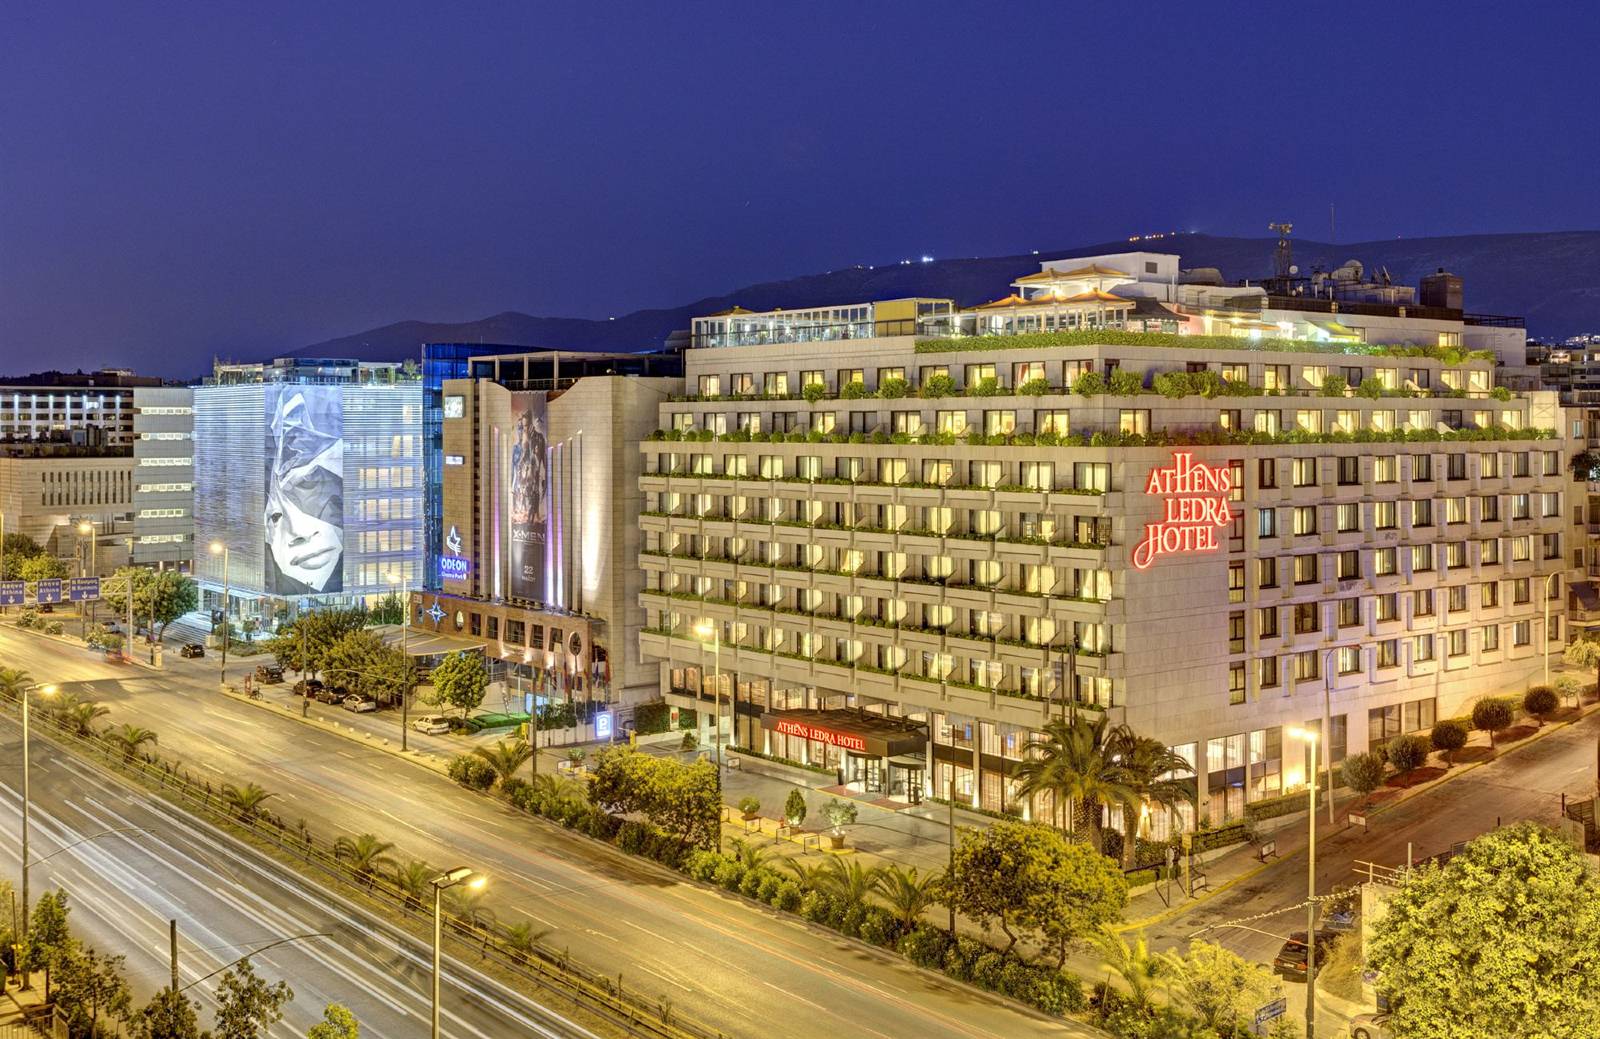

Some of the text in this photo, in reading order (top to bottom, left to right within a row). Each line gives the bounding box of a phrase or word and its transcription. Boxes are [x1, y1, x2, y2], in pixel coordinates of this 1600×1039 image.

[1146, 453, 1230, 494] ATHENS
[1166, 496, 1232, 526] LEDRA
[1134, 524, 1219, 568] HOTEL
[441, 558, 467, 571] ODEON
[777, 721, 866, 751] ATHENS LEDRA HOTEL
